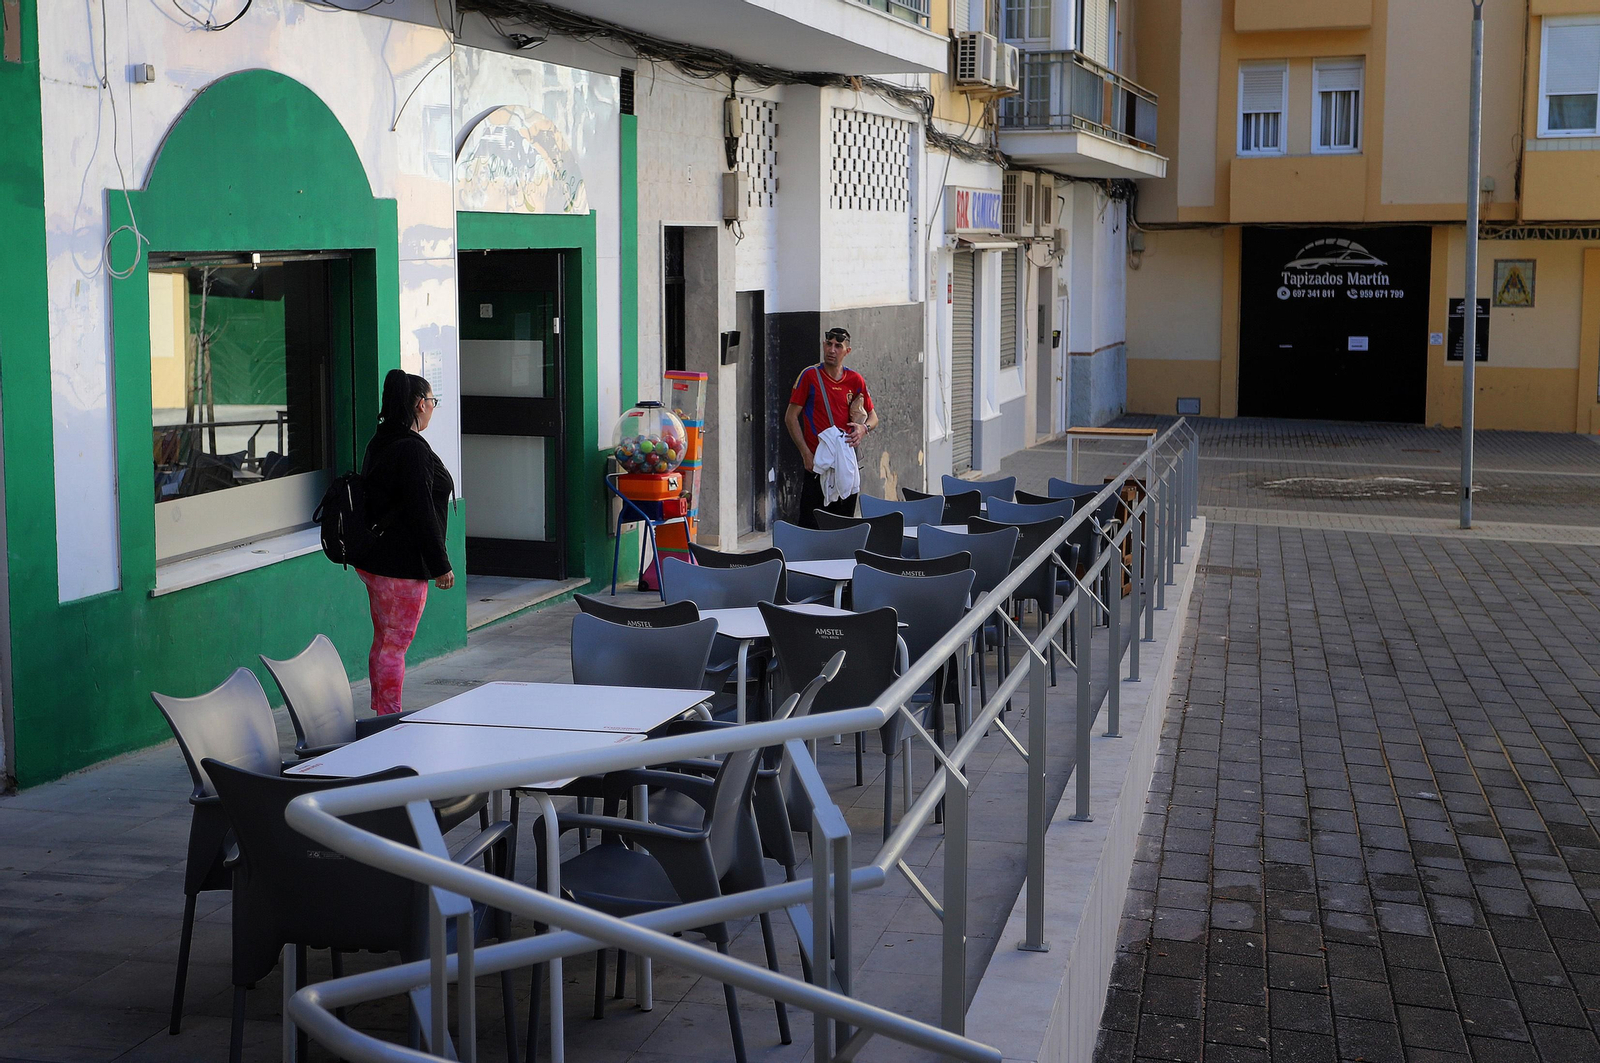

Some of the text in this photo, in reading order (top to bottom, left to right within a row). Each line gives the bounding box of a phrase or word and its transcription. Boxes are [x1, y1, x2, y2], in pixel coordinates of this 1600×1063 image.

[1479, 227, 1600, 240] RMANDAD
[1281, 271, 1390, 287] Tapizados Martín
[627, 620, 653, 628] AMSTEL
[815, 628, 844, 636] AMSTEL
